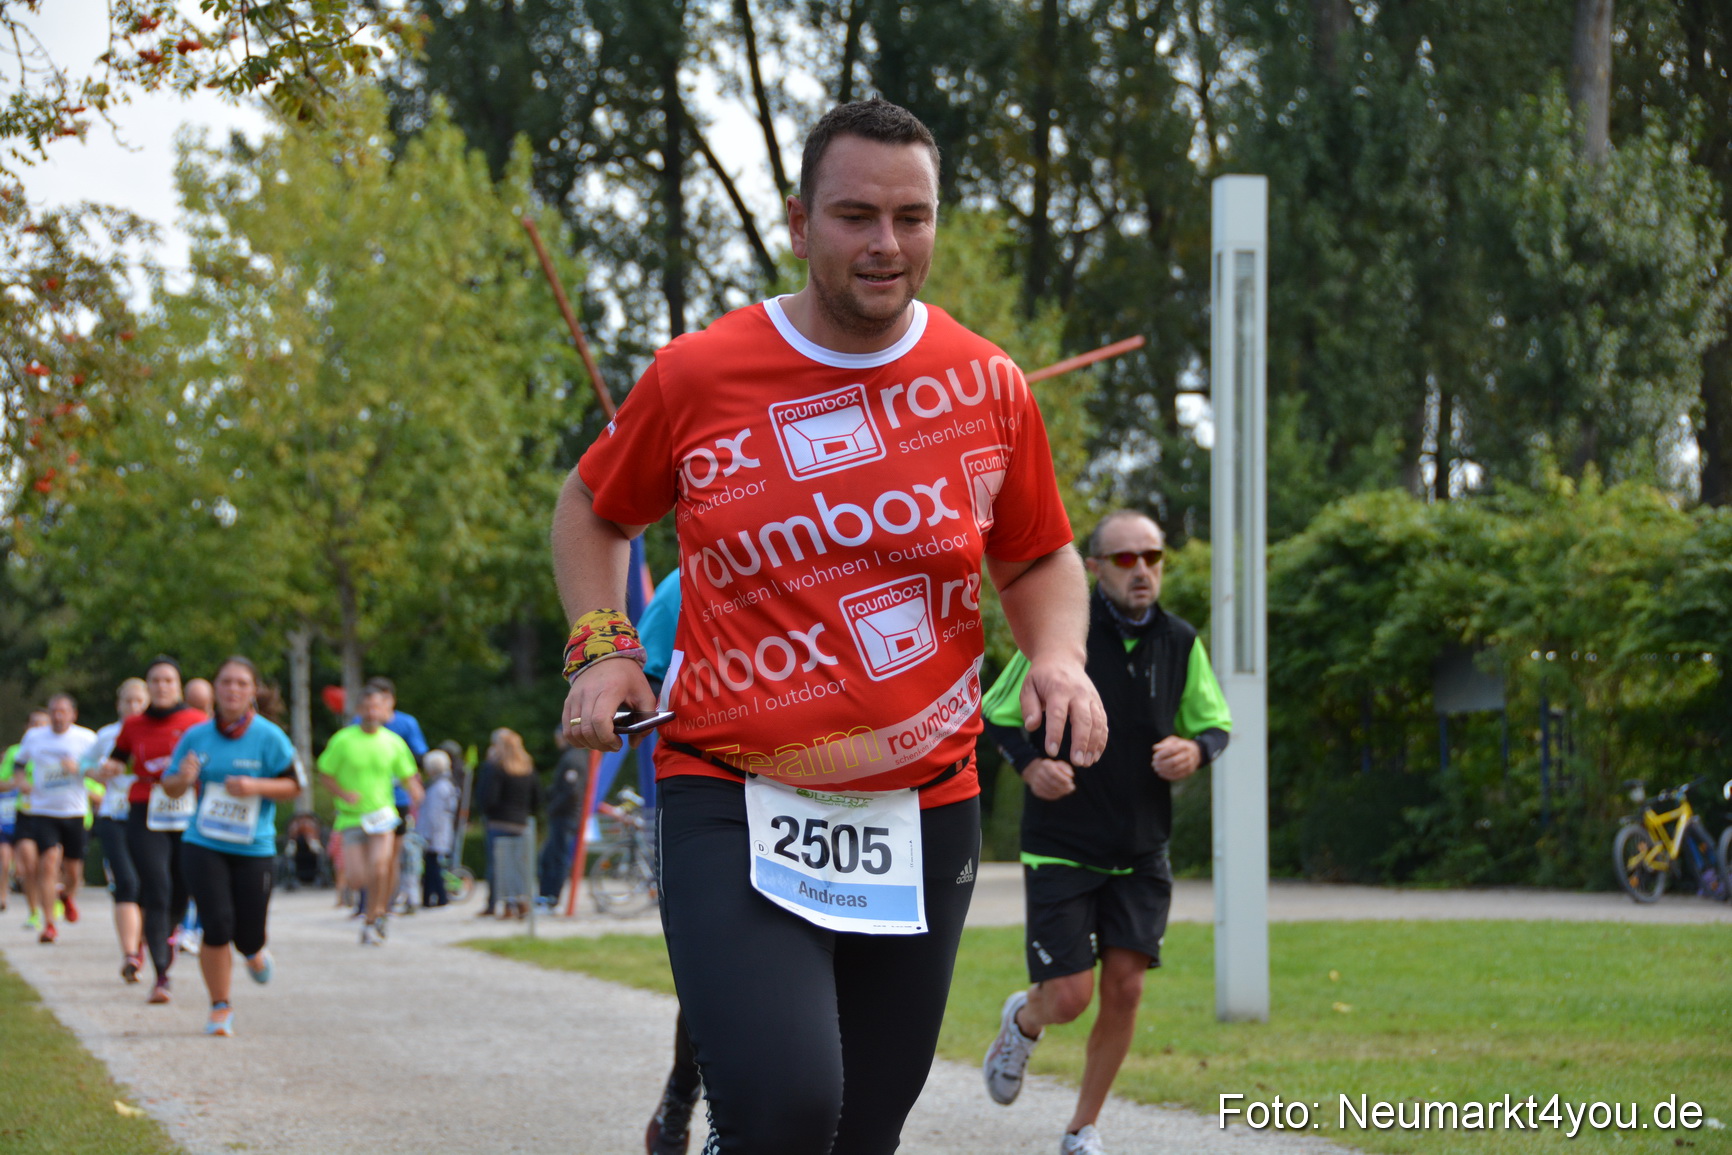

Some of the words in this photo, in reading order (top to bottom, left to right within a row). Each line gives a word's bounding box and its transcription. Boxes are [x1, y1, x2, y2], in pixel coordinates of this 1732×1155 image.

[777, 391, 860, 423] raumbox
[899, 418, 987, 454] schenken
[698, 479, 766, 514] outdoor
[688, 476, 960, 593] raumbox
[783, 557, 869, 593] wohnen
[888, 531, 969, 563] outdoor
[848, 583, 924, 618] raumbox
[685, 704, 749, 732] wohnen
[765, 678, 847, 711] outdoor
[887, 688, 967, 755] raumbox
[705, 725, 883, 778] Team
[895, 743, 929, 765] schenken
[770, 815, 892, 875] 2505
[798, 880, 868, 908] Andreas
[956, 873, 974, 884] adidas
